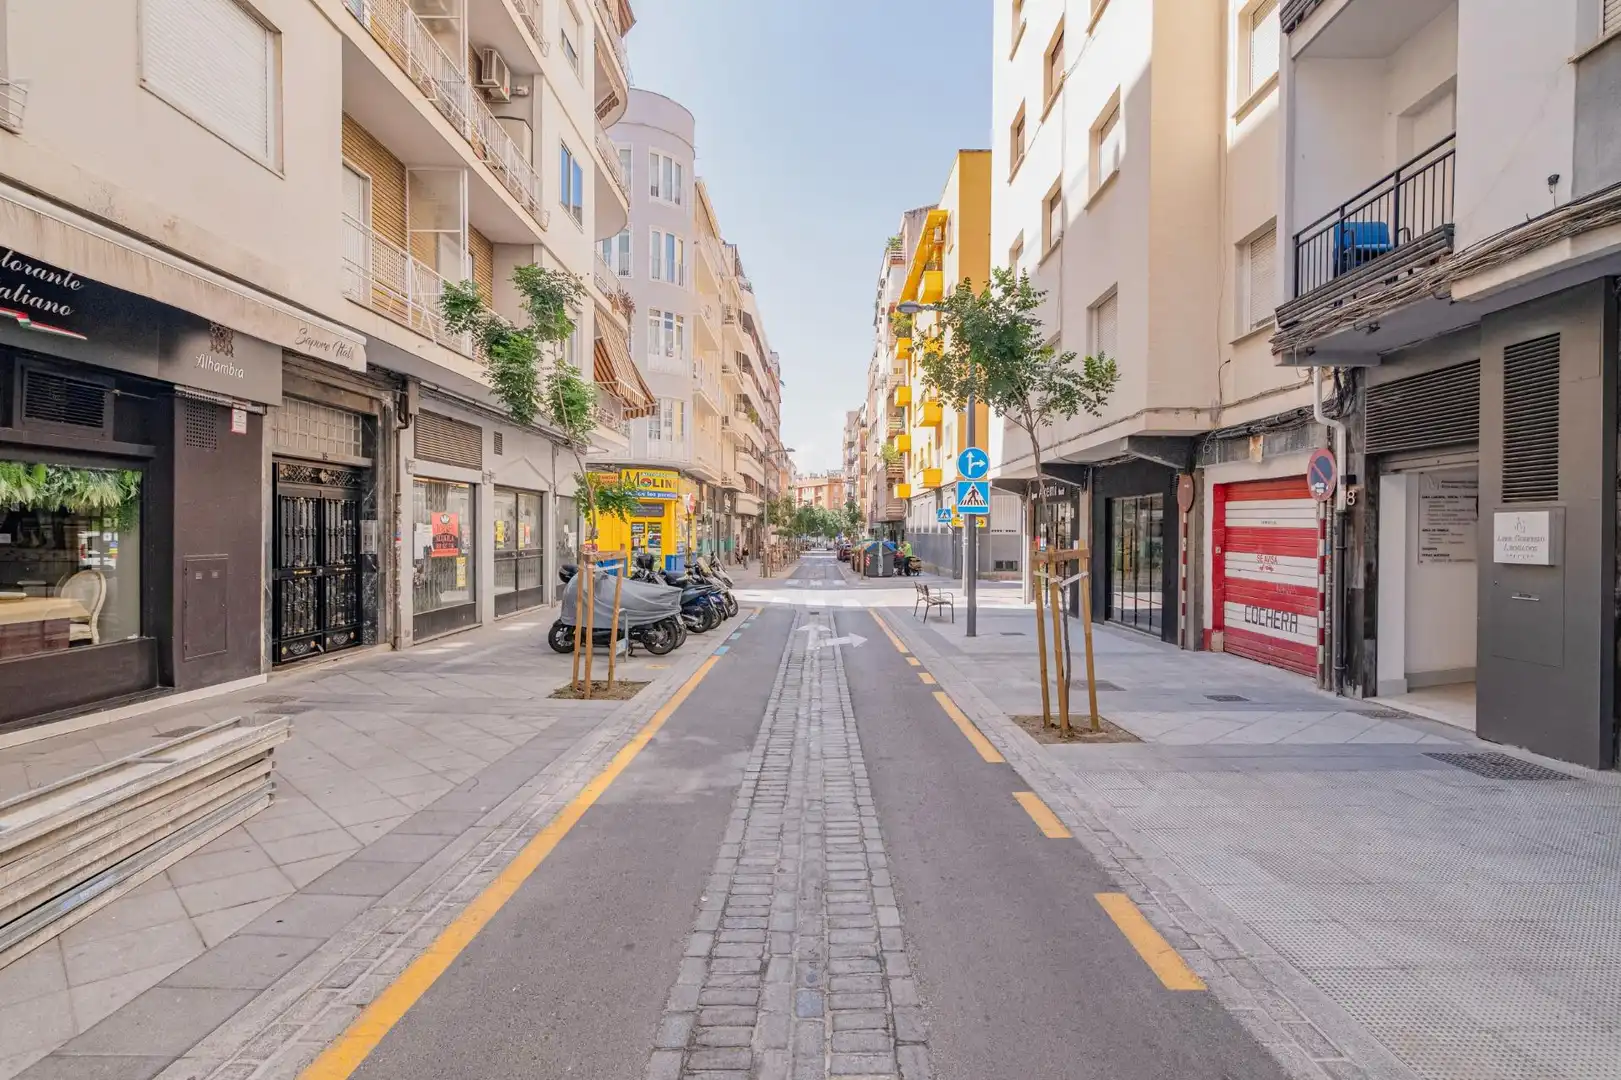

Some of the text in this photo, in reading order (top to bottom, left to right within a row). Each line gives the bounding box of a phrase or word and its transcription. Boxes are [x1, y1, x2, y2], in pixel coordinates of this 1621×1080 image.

[194, 353, 245, 379] Alhambra
[1346, 490, 1356, 506] 8
[1244, 604, 1298, 634] COCHERA
